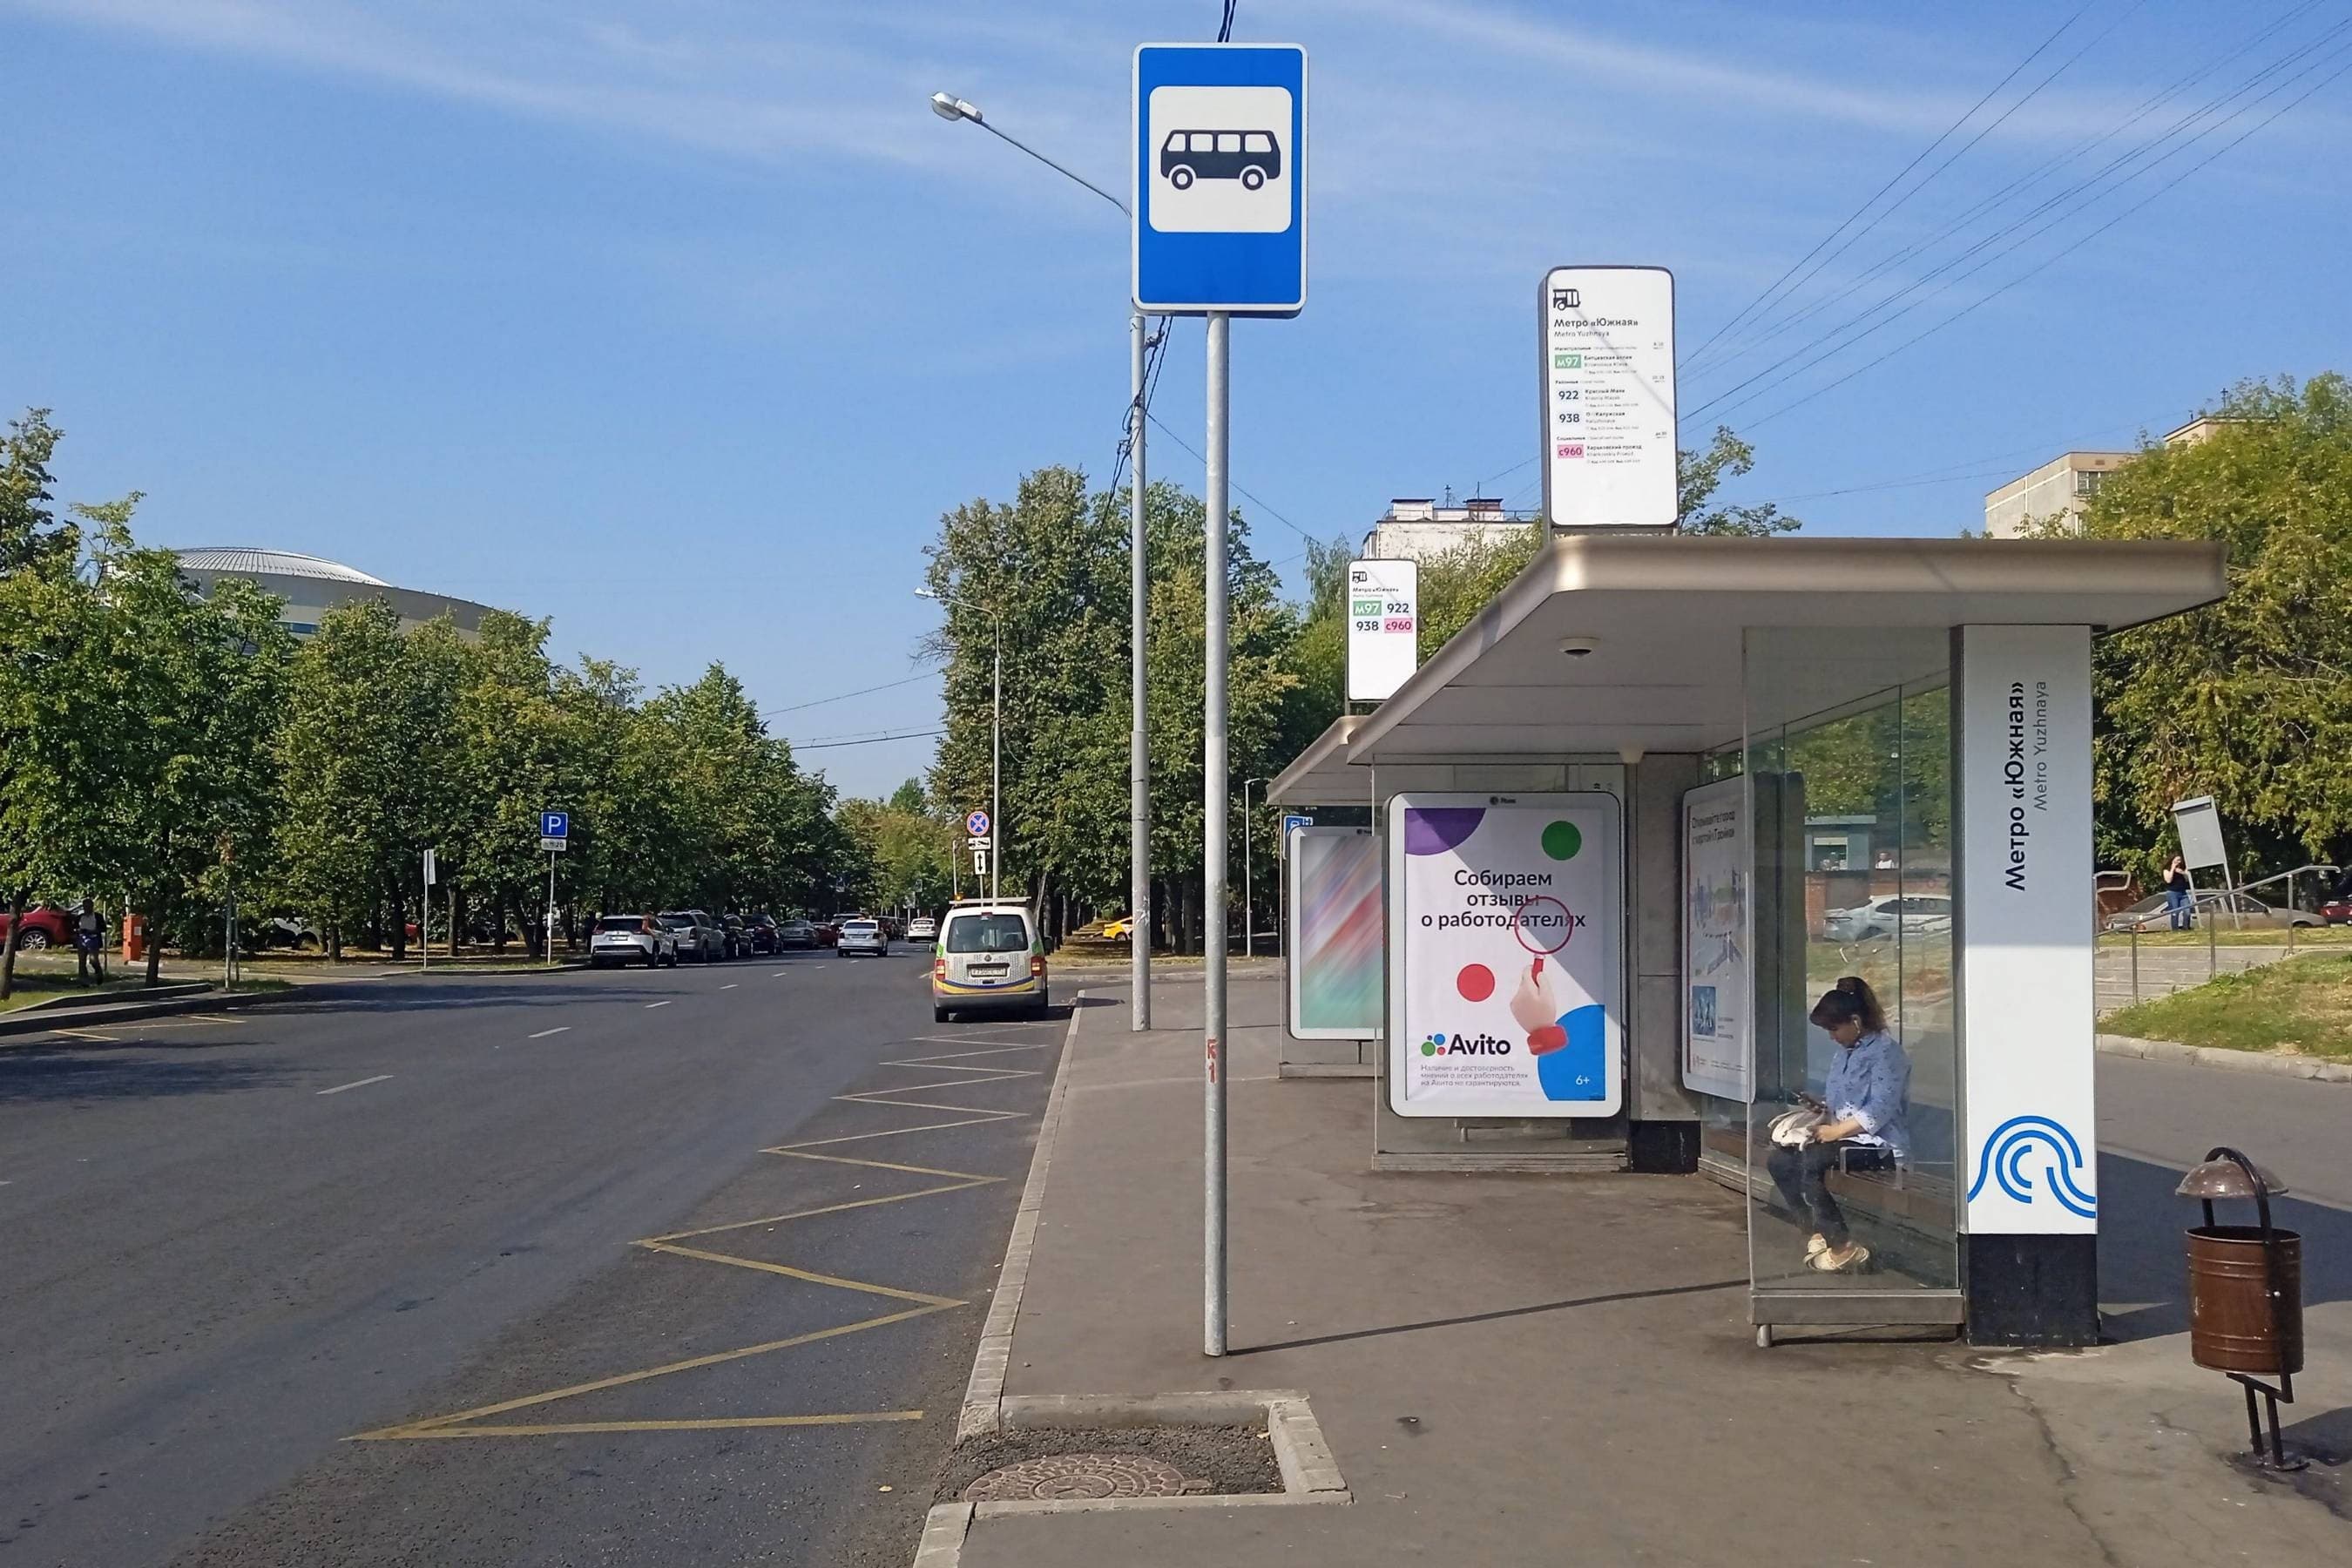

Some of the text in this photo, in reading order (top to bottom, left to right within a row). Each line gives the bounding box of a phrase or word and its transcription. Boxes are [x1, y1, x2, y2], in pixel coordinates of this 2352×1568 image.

[1554, 318, 1639, 329] Метро «Южная»
[1558, 390, 1579, 400] 922
[1558, 413, 1580, 423] 938
[1387, 603, 1409, 614] 922
[1356, 620, 1380, 632] 938
[2033, 681, 2049, 811] Metro Yuzhnaya
[2004, 681, 2030, 891] Метро «Южная»
[548, 815, 562, 834] P
[1454, 869, 1552, 889] Собираем
[1466, 894, 1540, 907] отзывы
[1421, 911, 1586, 930] о работодателях
[1448, 1033, 1511, 1056] Avito
[1575, 1075, 1591, 1085] 6+
